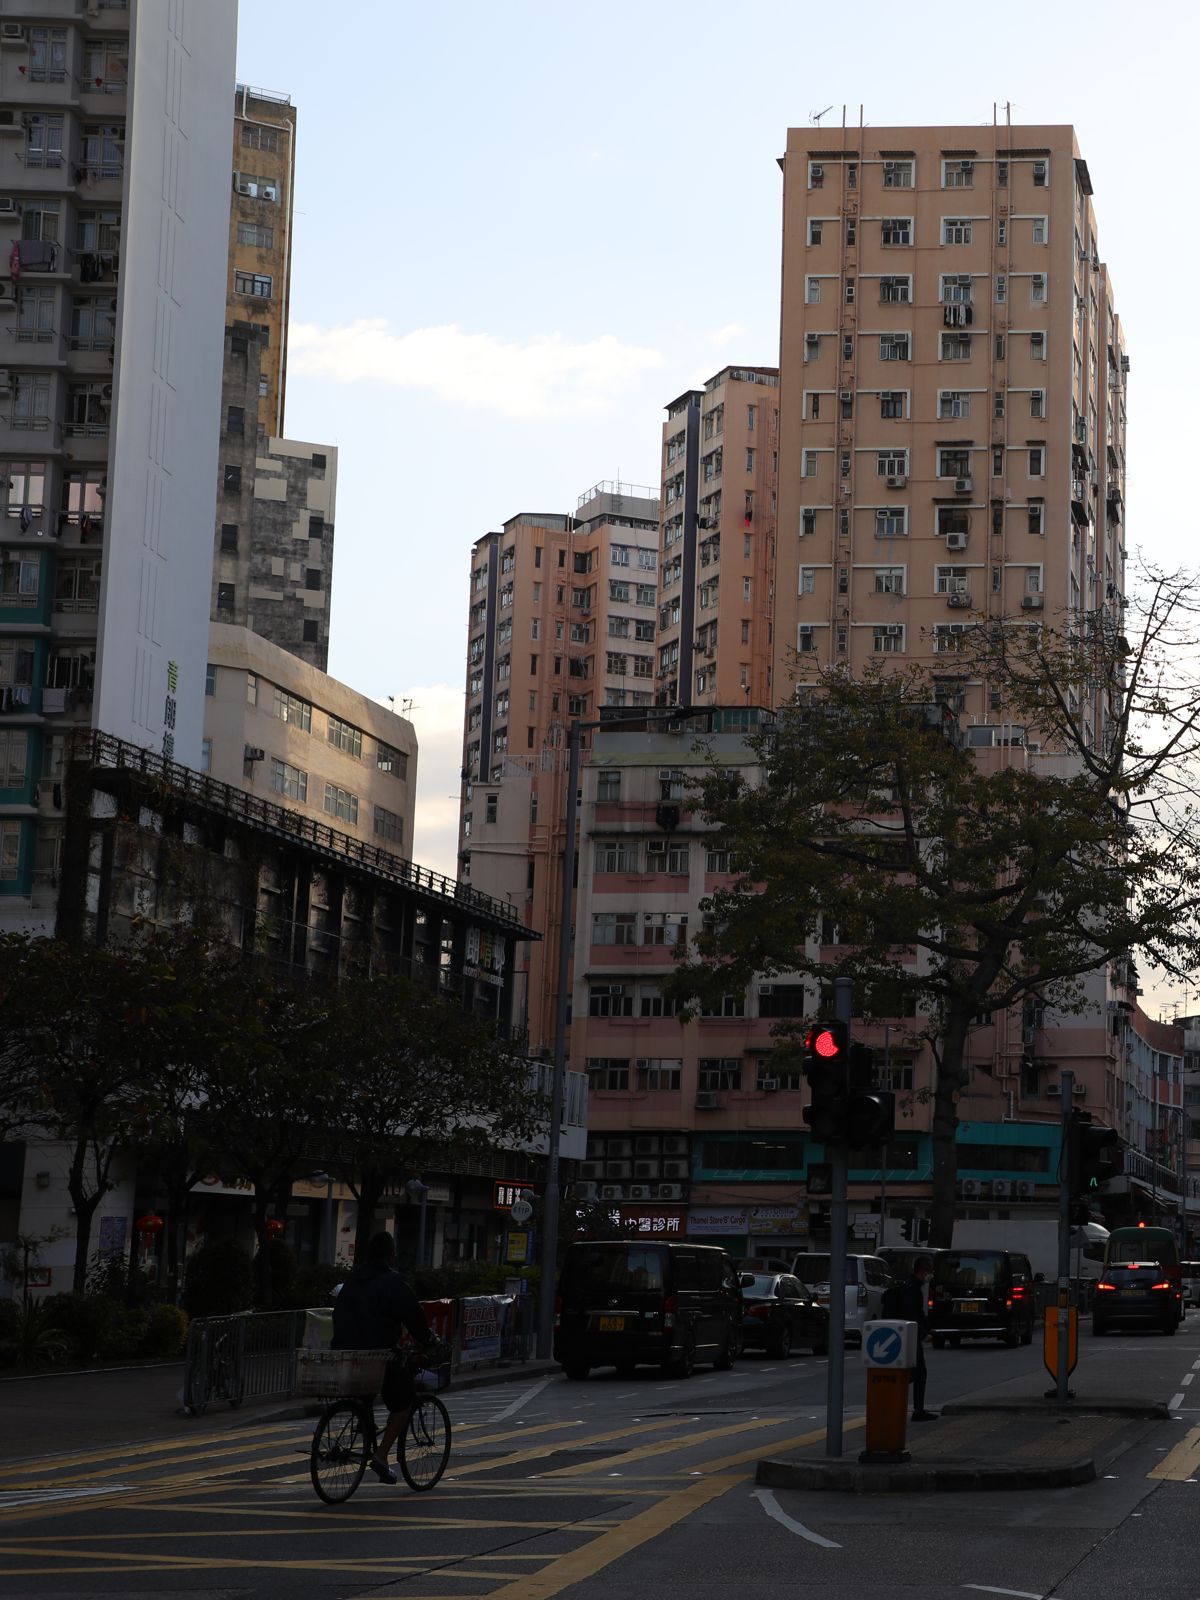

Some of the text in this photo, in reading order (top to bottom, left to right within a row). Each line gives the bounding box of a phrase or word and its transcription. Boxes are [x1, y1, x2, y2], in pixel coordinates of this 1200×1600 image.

[624, 1216, 680, 1233] 中醫診所
[689, 1216, 709, 1225] Thamel
[709, 1216, 723, 1225] Store
[730, 1215, 746, 1226] Cargo
